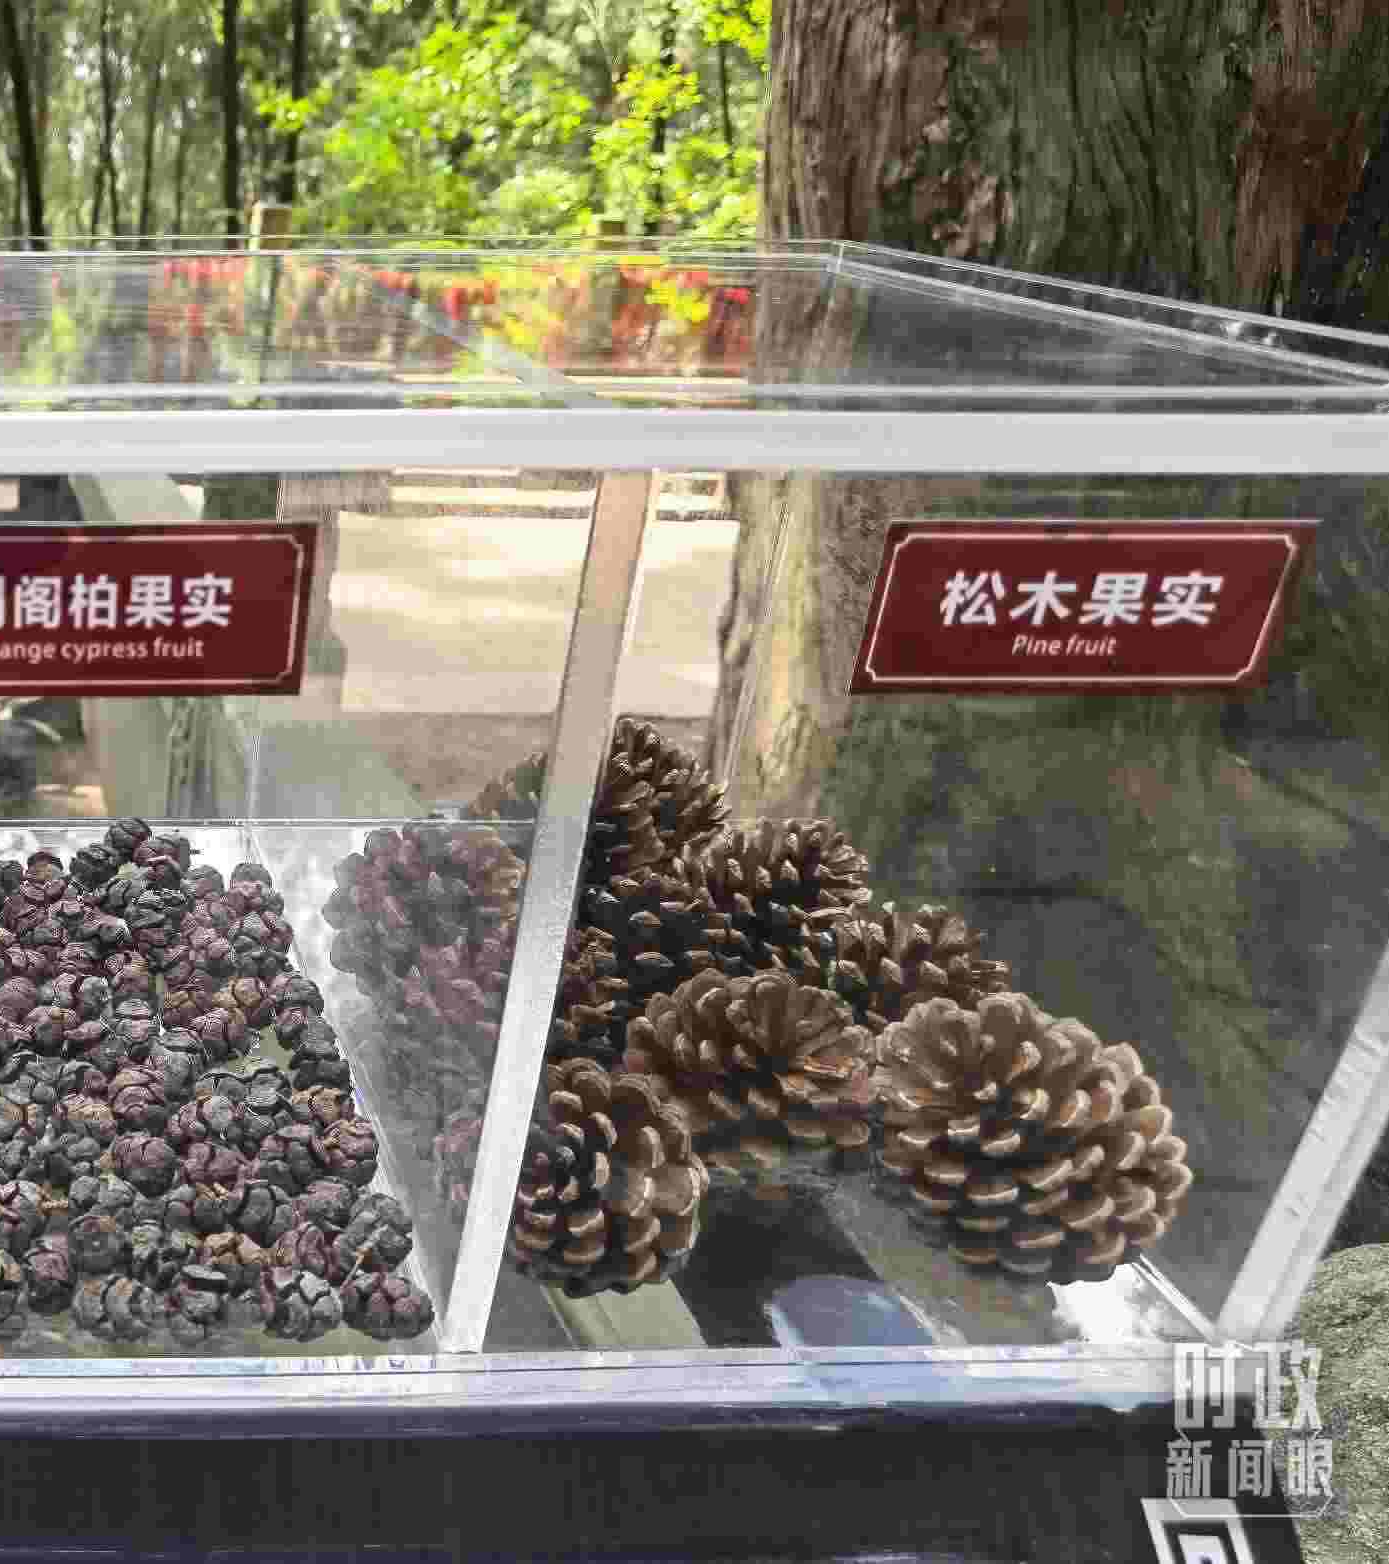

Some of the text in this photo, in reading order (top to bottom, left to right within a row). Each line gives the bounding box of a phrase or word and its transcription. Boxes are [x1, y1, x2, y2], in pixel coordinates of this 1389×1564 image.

[939, 570, 1224, 627] 松木果实
[61, 641, 148, 664] cypress
[153, 636, 204, 658] fruit
[1012, 634, 1117, 656] Pine fruit
